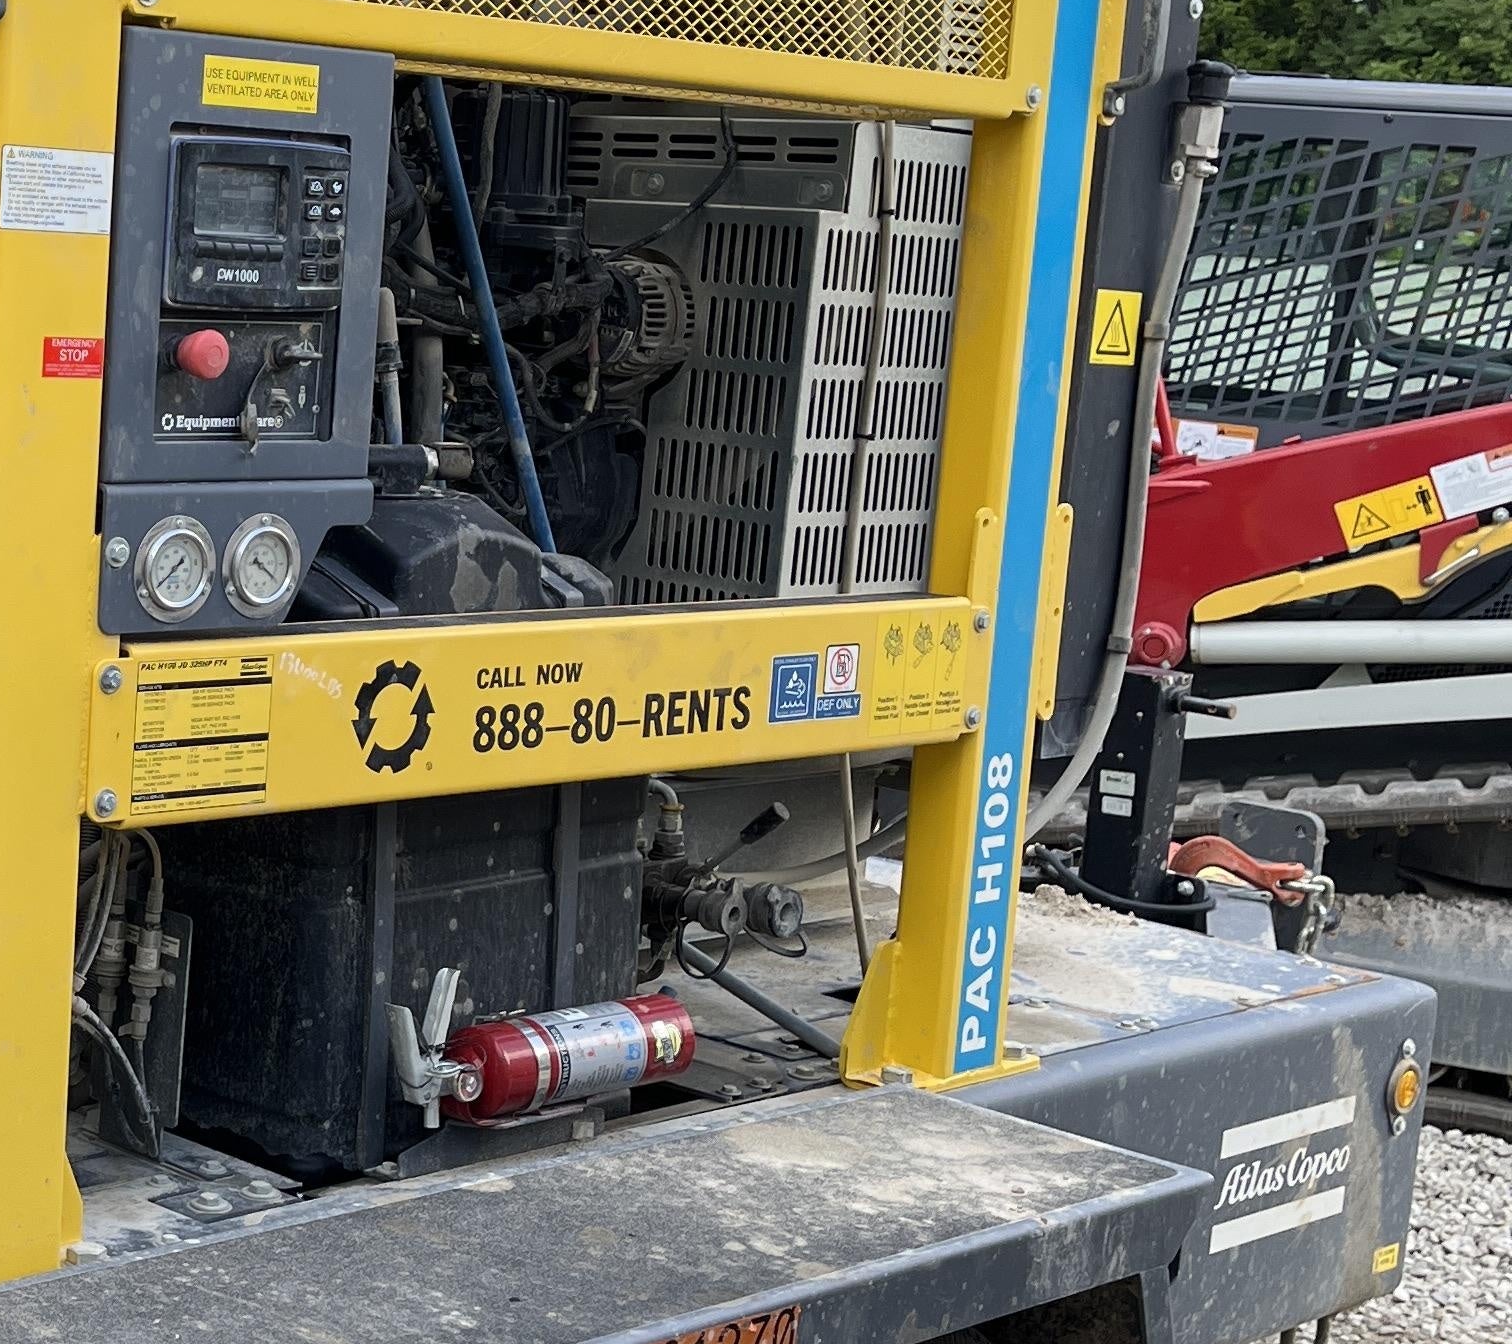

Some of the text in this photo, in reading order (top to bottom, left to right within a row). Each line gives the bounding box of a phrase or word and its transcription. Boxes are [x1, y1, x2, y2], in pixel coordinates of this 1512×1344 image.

[205, 67, 317, 88] USE EQUIPMENT IN WELL
[207, 83, 315, 102] VENTILATED AREA ONLY
[18, 150, 54, 160] WARNING
[216, 268, 260, 283] PW1000
[51, 338, 98, 348] EMERGENCY
[59, 348, 89, 362] STOP
[140, 661, 156, 671] PAC
[477, 662, 583, 689] CALL NOW
[817, 698, 835, 712] DEF
[836, 697, 859, 710] ONLY
[961, 752, 1013, 1053] PAC H108
